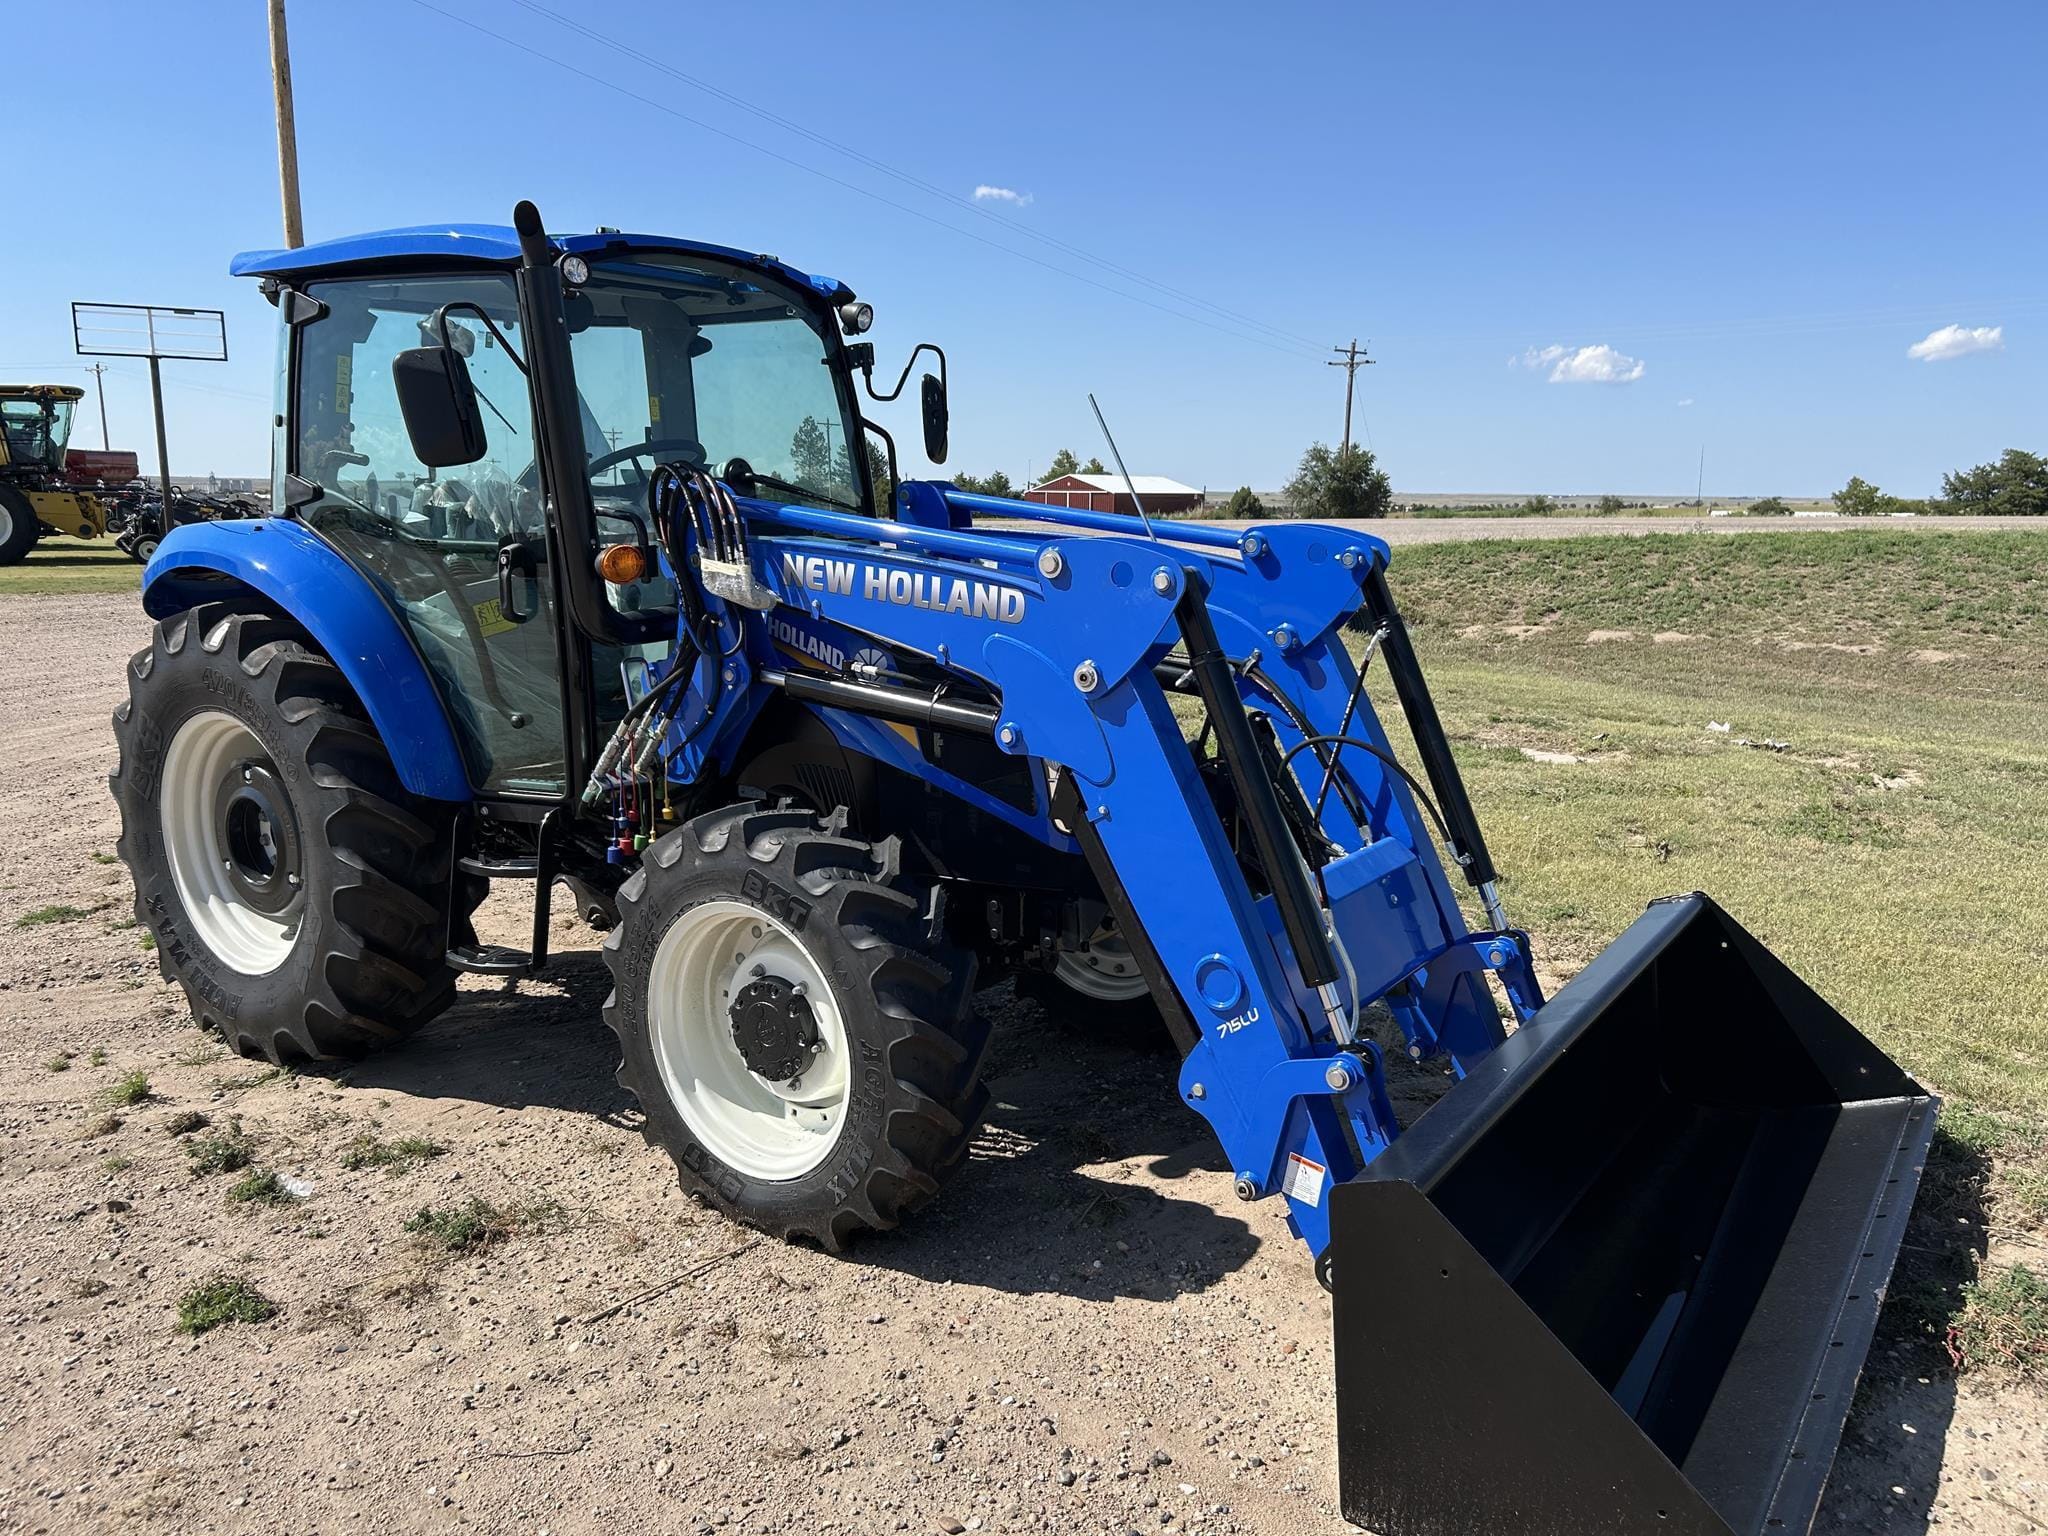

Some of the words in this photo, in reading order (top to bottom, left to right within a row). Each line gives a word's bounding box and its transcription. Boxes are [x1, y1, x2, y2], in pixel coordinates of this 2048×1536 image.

[783, 553, 856, 596] NEW
[863, 565, 1026, 625] HOLLAND
[767, 613, 844, 671] HOLLAND
[742, 869, 812, 932] BKT
[1216, 1007, 1259, 1039] 715LU
